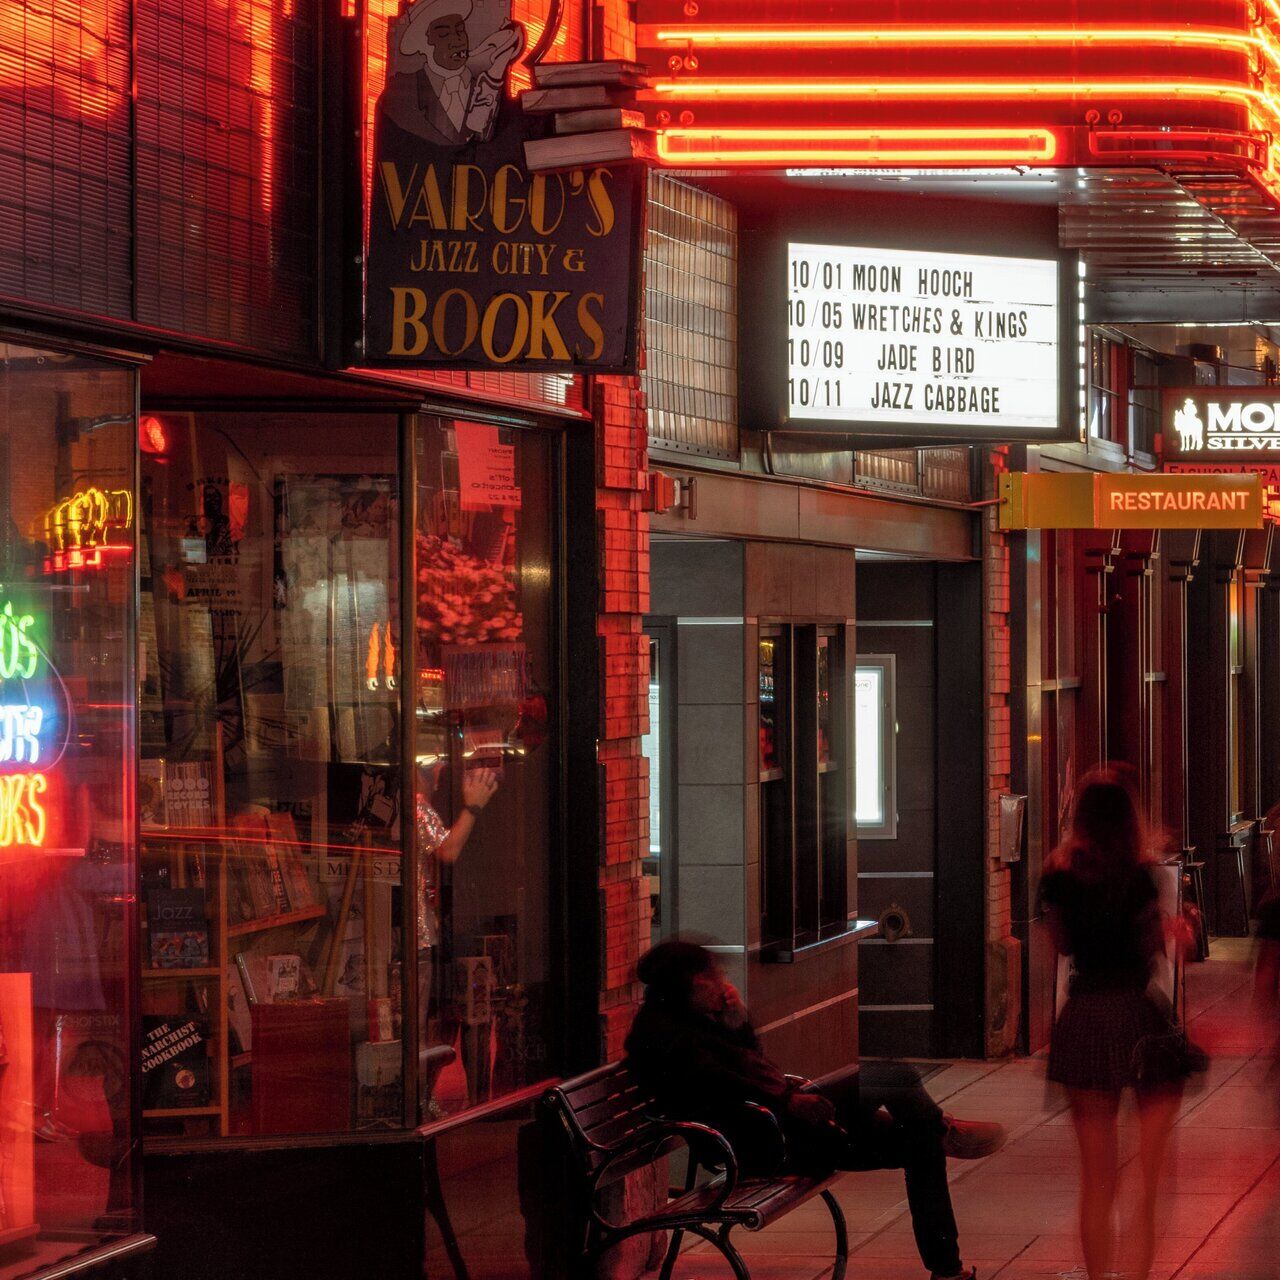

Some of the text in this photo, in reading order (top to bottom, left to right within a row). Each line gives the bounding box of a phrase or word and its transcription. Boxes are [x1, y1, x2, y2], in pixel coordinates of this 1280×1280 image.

[378, 161, 614, 237] VARGO'S
[410, 239, 586, 275] JAZZ CITY &
[791, 260, 973, 298] 10/01 MOON HOOCH
[386, 287, 605, 363] BOOKS
[787, 299, 1028, 338] 10/05 WRETCHES & KINGS
[787, 338, 975, 373] 10/09 JADE BIRD
[787, 378, 1000, 413] 10/11 JAZZ CABBAGE
[1109, 490, 1250, 513] RESTAURANT
[141, 1021, 196, 1059] NARCHIST
[147, 1023, 170, 1040] THE
[141, 1032, 202, 1072] COOKBOOK
